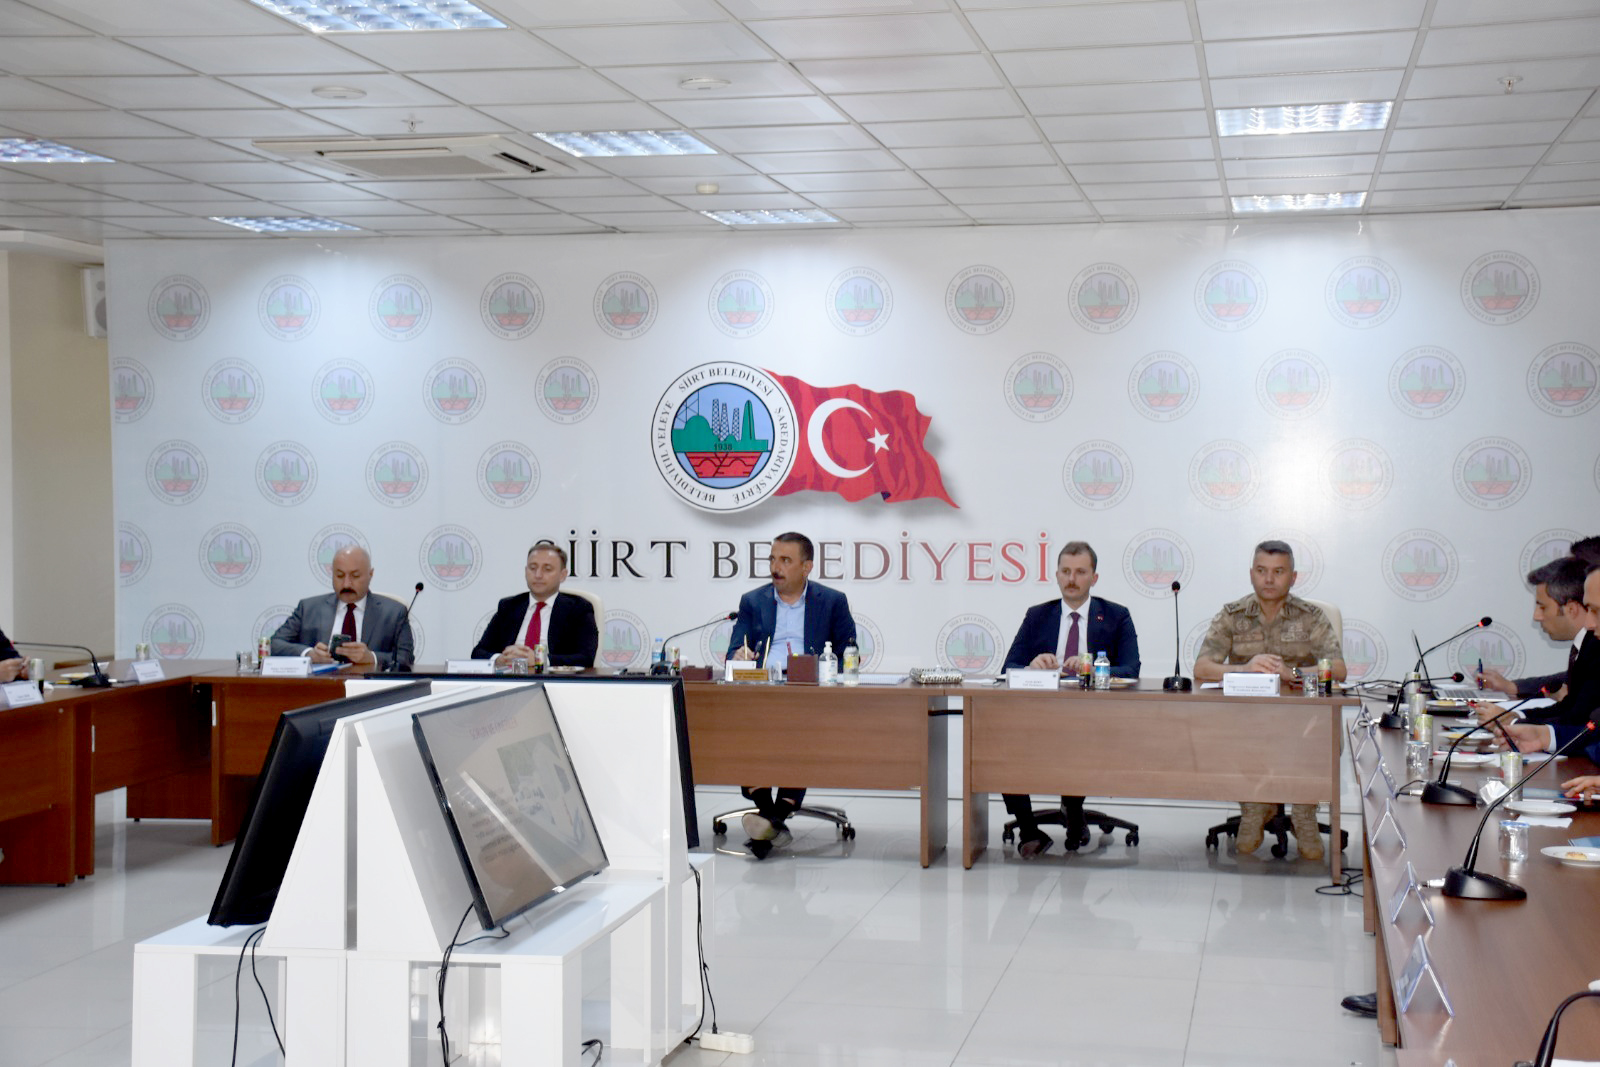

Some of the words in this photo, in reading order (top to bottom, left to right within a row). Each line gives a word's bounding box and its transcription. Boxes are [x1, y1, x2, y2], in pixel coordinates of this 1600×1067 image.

[678, 368, 706, 393] SİİRT
[709, 367, 775, 397] BELEDİYESİ
[534, 529, 688, 579] İİRT
[711, 530, 1051, 583] BEEDİYESİ
